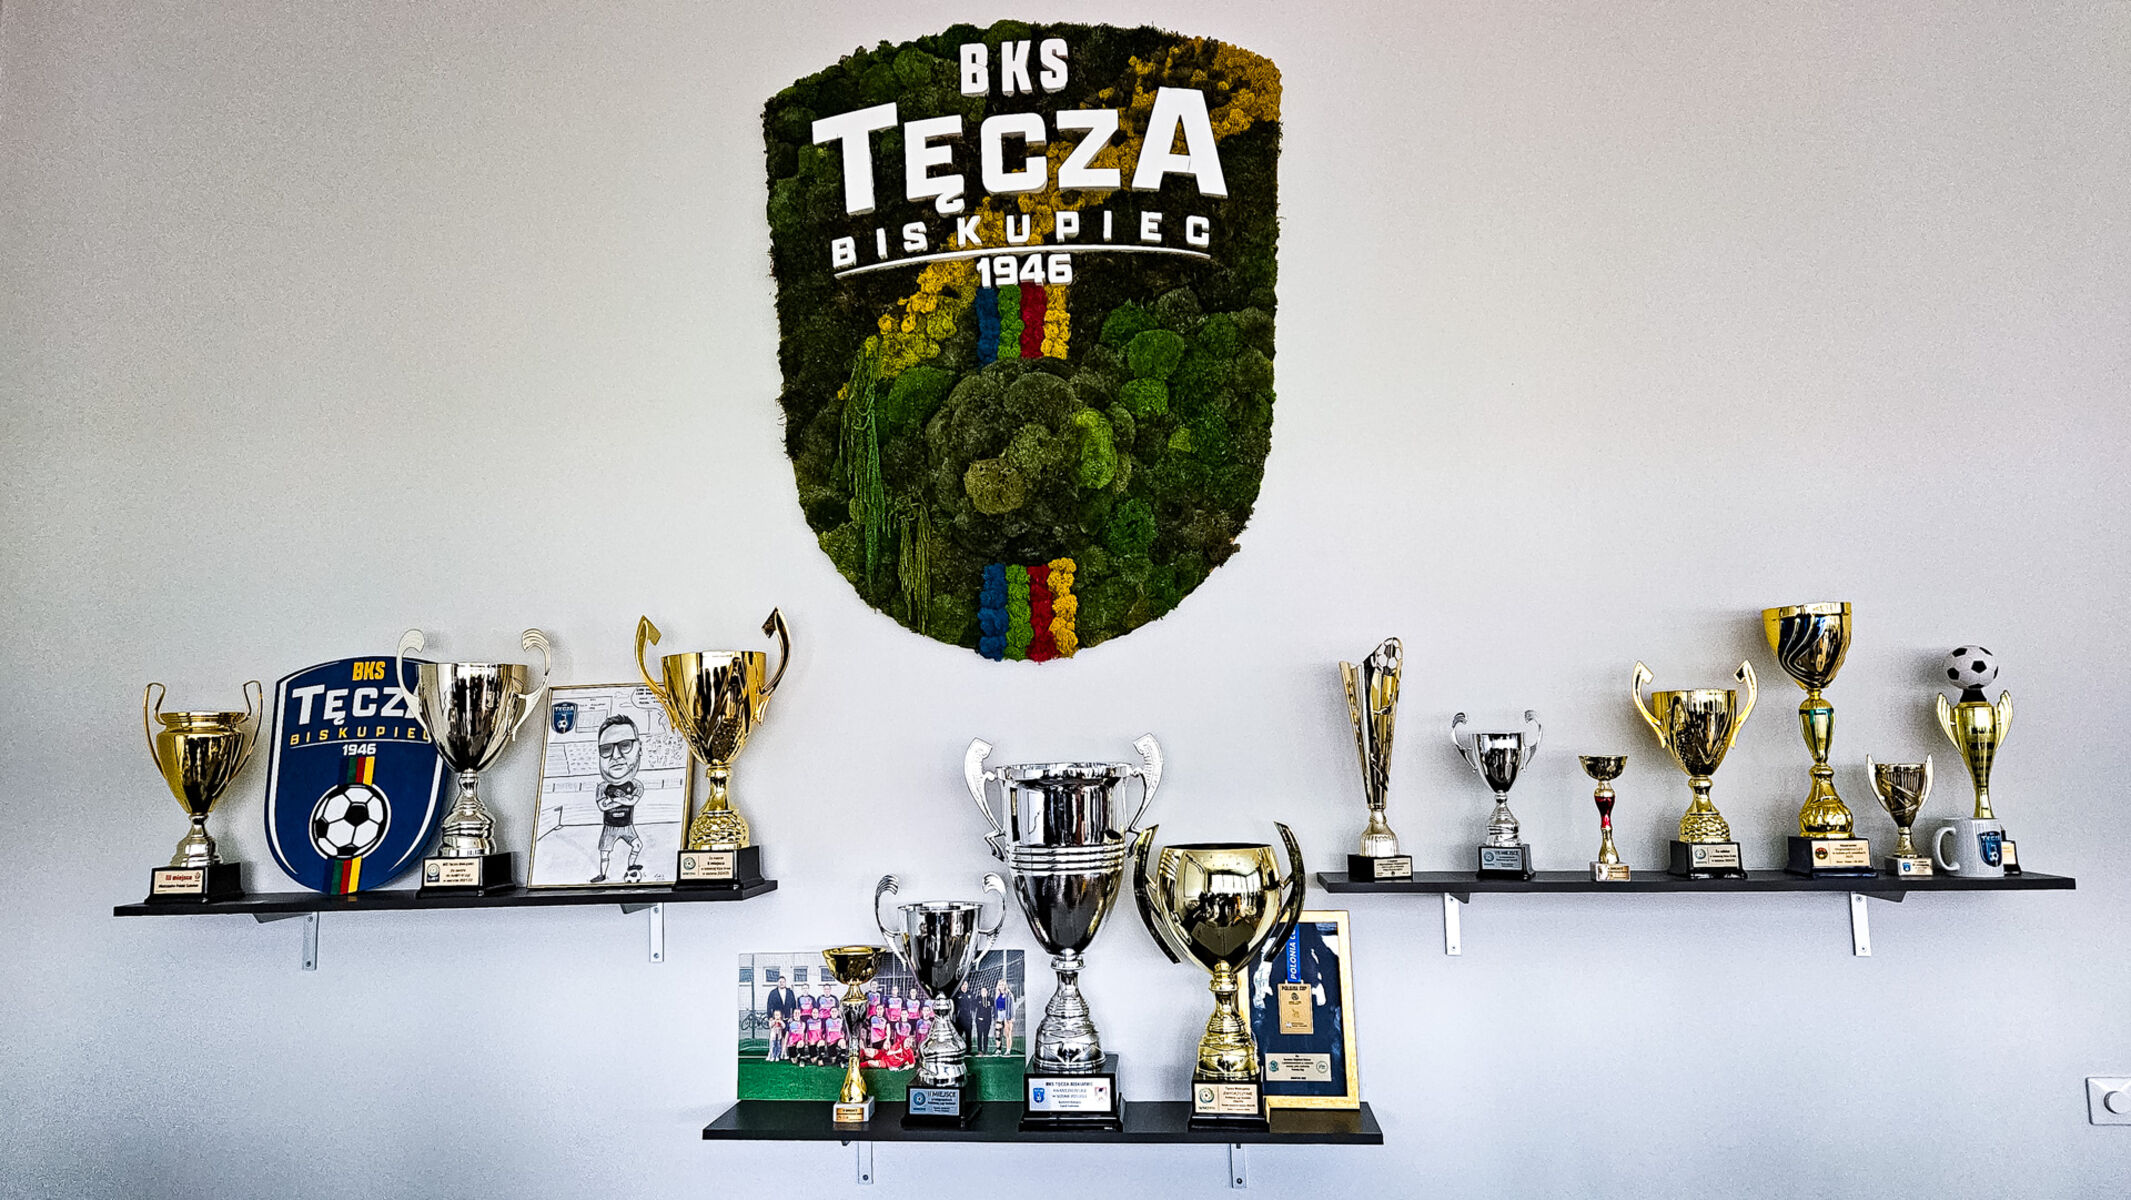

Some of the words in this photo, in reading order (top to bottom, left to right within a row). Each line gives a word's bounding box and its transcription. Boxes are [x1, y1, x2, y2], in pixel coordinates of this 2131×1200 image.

[960, 38, 1069, 96] BKS
[811, 86, 1228, 216] TĘCZA
[831, 210, 1211, 270] BISKUPIEC
[976, 253, 1072, 286] 1946
[352, 661, 386, 681] BKS
[343, 743, 376, 756] 1946
[1289, 941, 1297, 980] POLONIA
